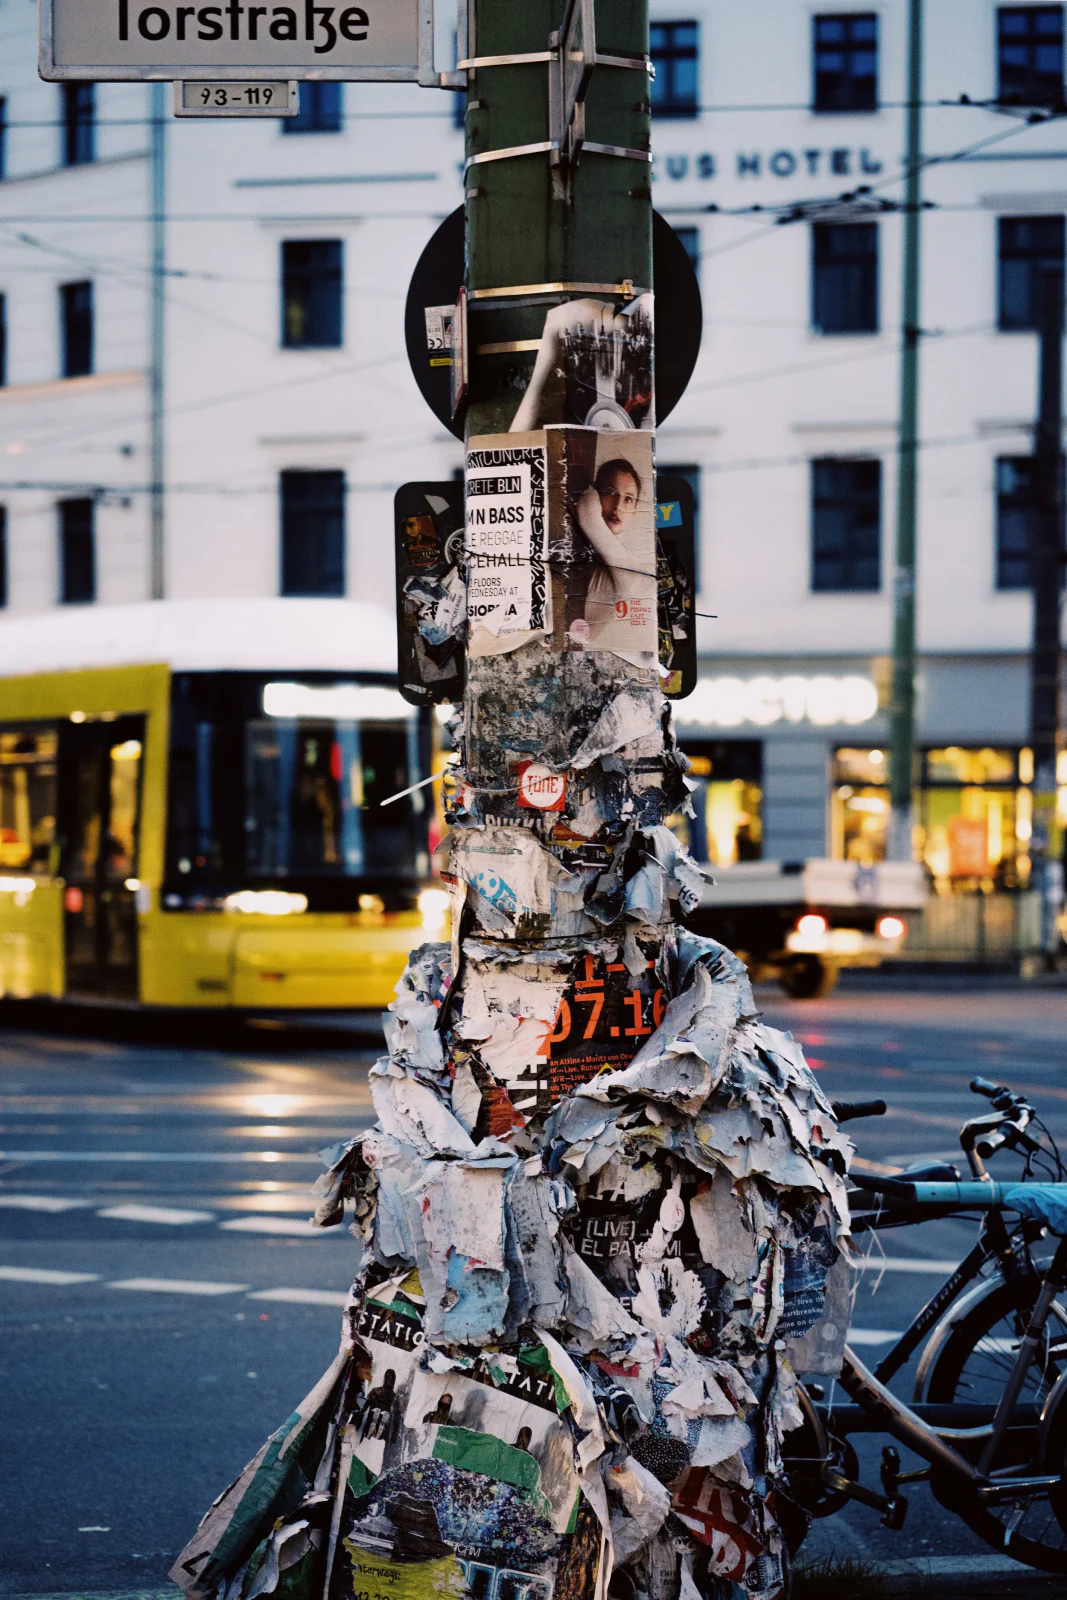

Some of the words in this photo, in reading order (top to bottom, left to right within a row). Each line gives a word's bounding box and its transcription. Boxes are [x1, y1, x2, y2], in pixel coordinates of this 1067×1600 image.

[651, 152, 717, 181] US
[736, 147, 883, 179] HOTEL
[497, 477, 520, 493] BLN
[489, 505, 525, 525] BASS
[480, 529, 525, 547] REGGAE
[468, 587, 508, 599] EDNESDAY
[615, 600, 628, 619] 9
[586, 1219, 636, 1241] [LIVE]
[581, 1237, 604, 1258] EL
